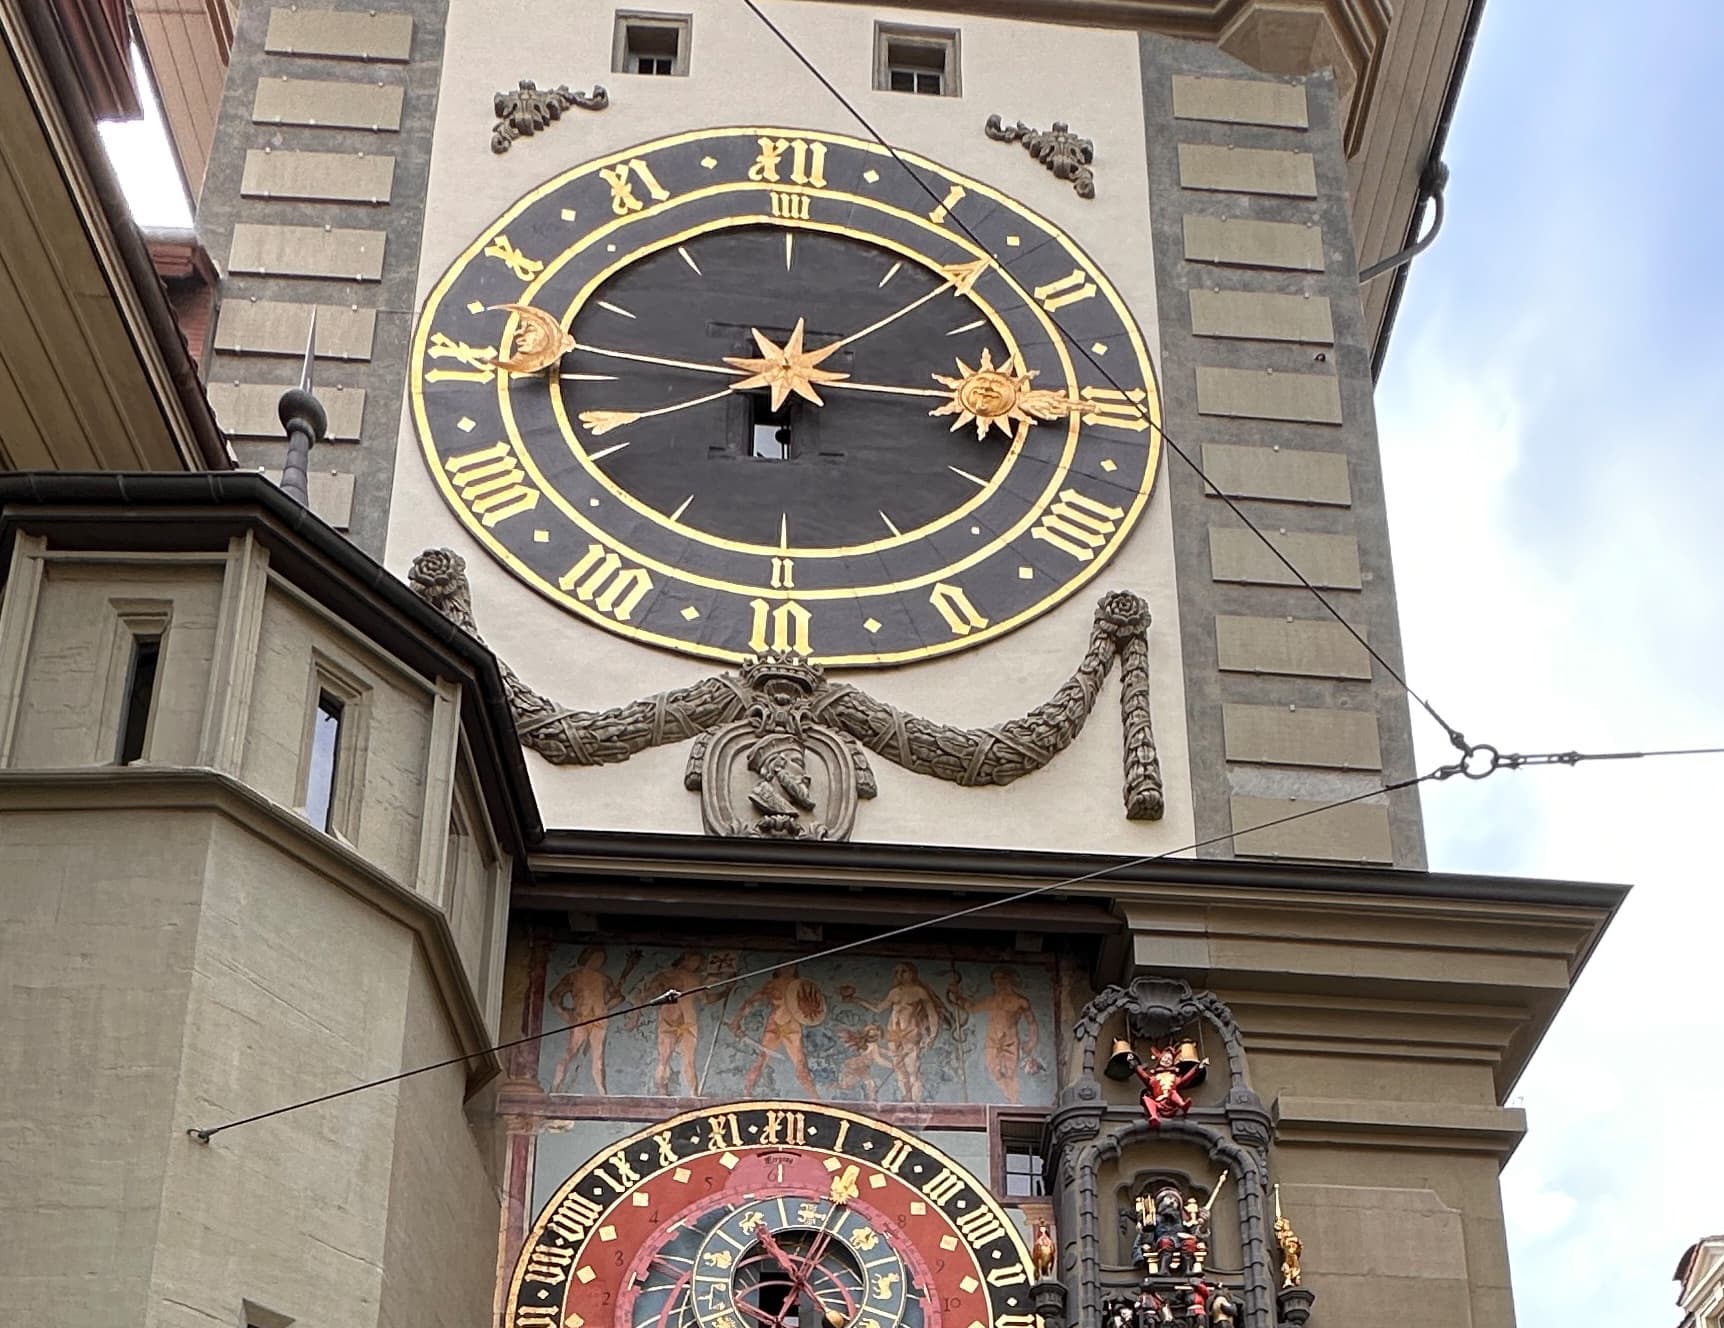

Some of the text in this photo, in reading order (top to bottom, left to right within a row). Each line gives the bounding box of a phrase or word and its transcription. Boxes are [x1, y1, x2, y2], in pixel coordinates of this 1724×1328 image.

[748, 137, 827, 188] XII
[599, 159, 670, 216] XI
[769, 191, 811, 220] IIII
[928, 185, 966, 223] I
[484, 234, 544, 281] X
[1034, 269, 1097, 312] II
[1031, 488, 1125, 561] IIII
[770, 557, 795, 589] II
[708, 1113, 744, 1151] XI
[759, 1110, 806, 1146] XII
[833, 1119, 850, 1153] I
[652, 1130, 679, 1167] X
[880, 1139, 913, 1174] II
[593, 1151, 641, 1193] IX
[922, 1167, 966, 1207] III
[649, 1209, 659, 1224] 4
[956, 1204, 1006, 1250] IIII
[614, 1250, 624, 1267] 3
[935, 1258, 945, 1273] 9
[601, 1291, 611, 1306] 2
